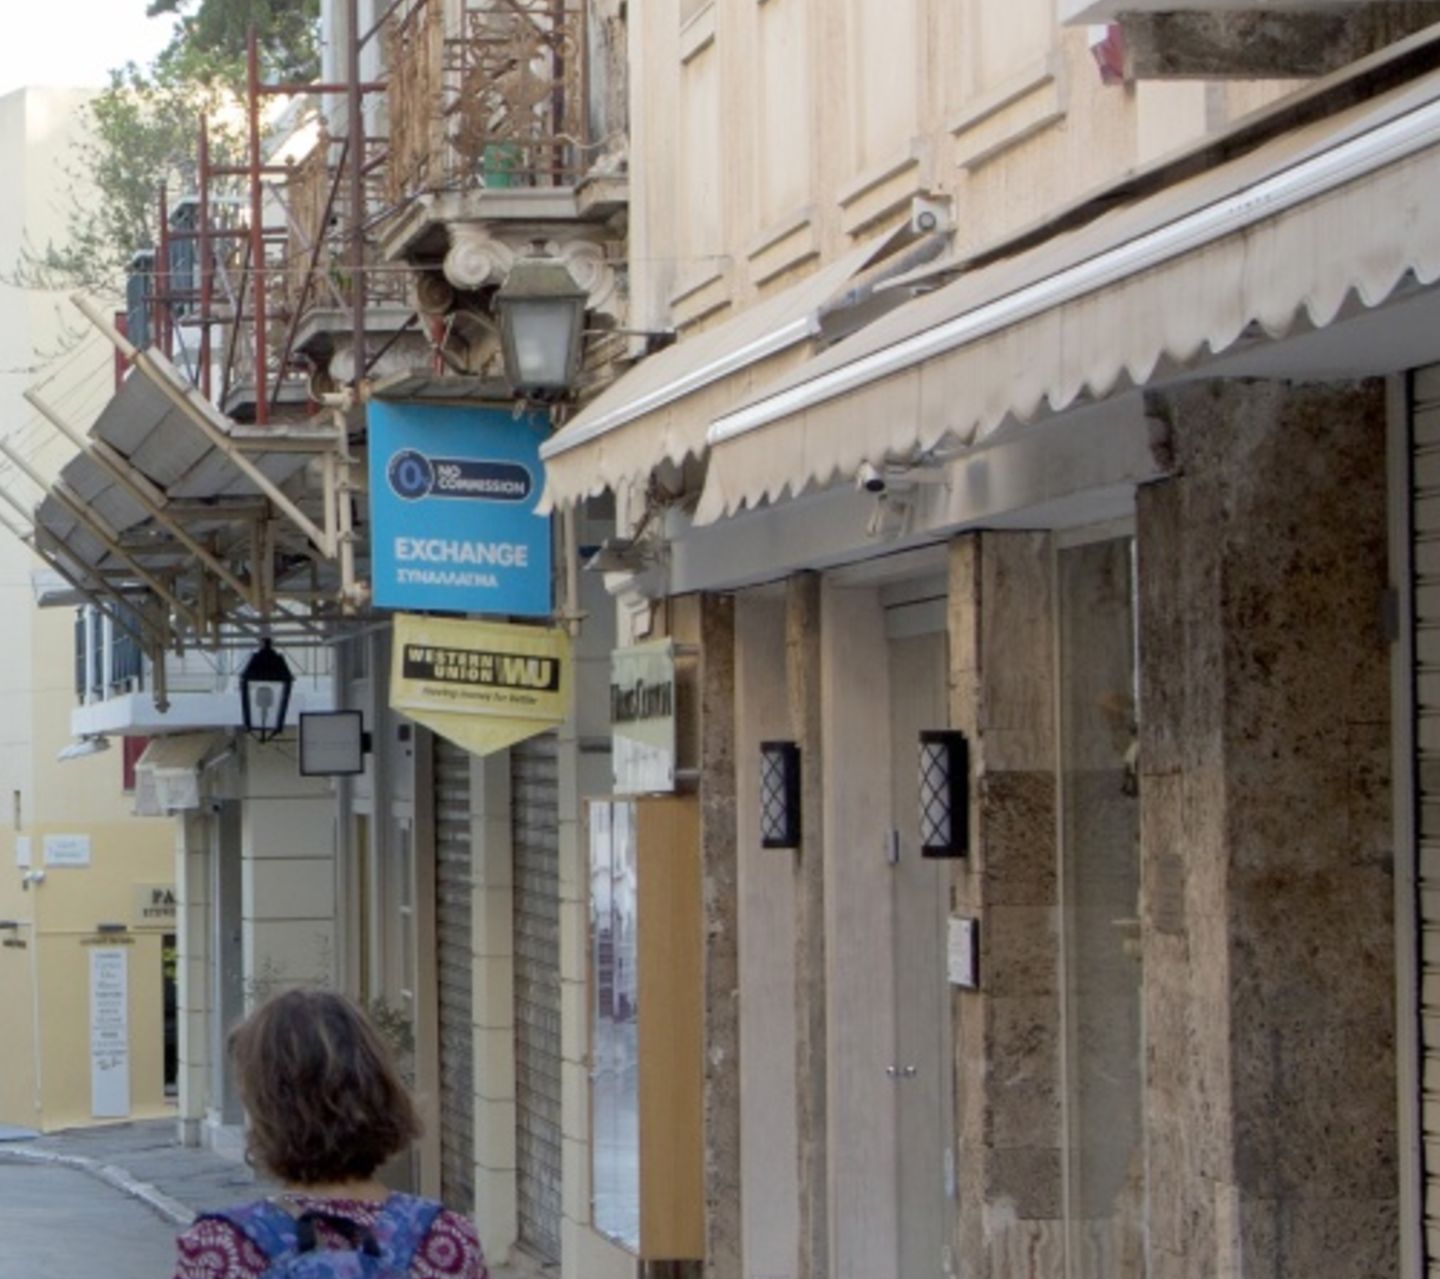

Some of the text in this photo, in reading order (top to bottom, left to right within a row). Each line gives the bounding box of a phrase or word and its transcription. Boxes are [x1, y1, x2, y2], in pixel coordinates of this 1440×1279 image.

[437, 464, 462, 479] NO
[437, 477, 526, 495] COMMISSION
[394, 536, 529, 568] EXCHANGE
[408, 647, 494, 669] WESTERN
[433, 665, 494, 683] UNION
